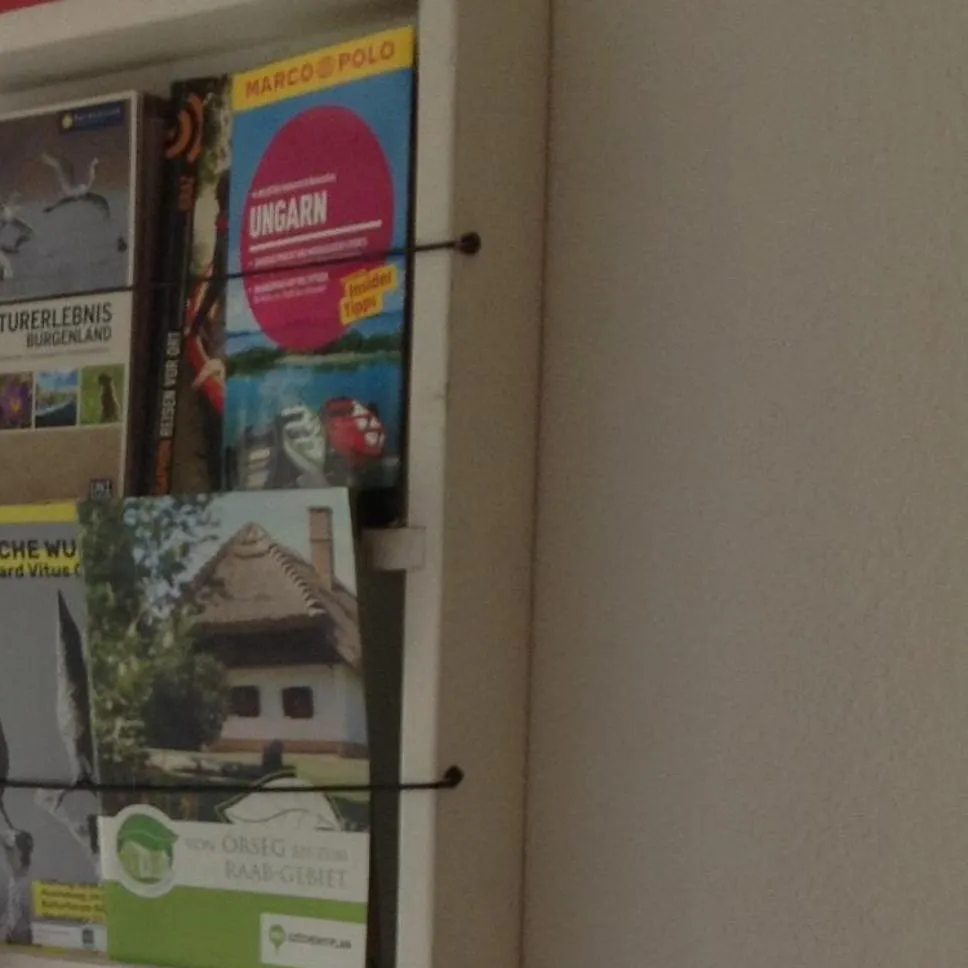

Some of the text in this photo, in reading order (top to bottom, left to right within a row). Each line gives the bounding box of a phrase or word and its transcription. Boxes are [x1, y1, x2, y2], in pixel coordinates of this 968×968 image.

[244, 40, 395, 99] MARCO POLO
[248, 190, 328, 239] UNGARN
[25, 324, 113, 349] BURGENLAND
[27, 562, 71, 579] Vitus
